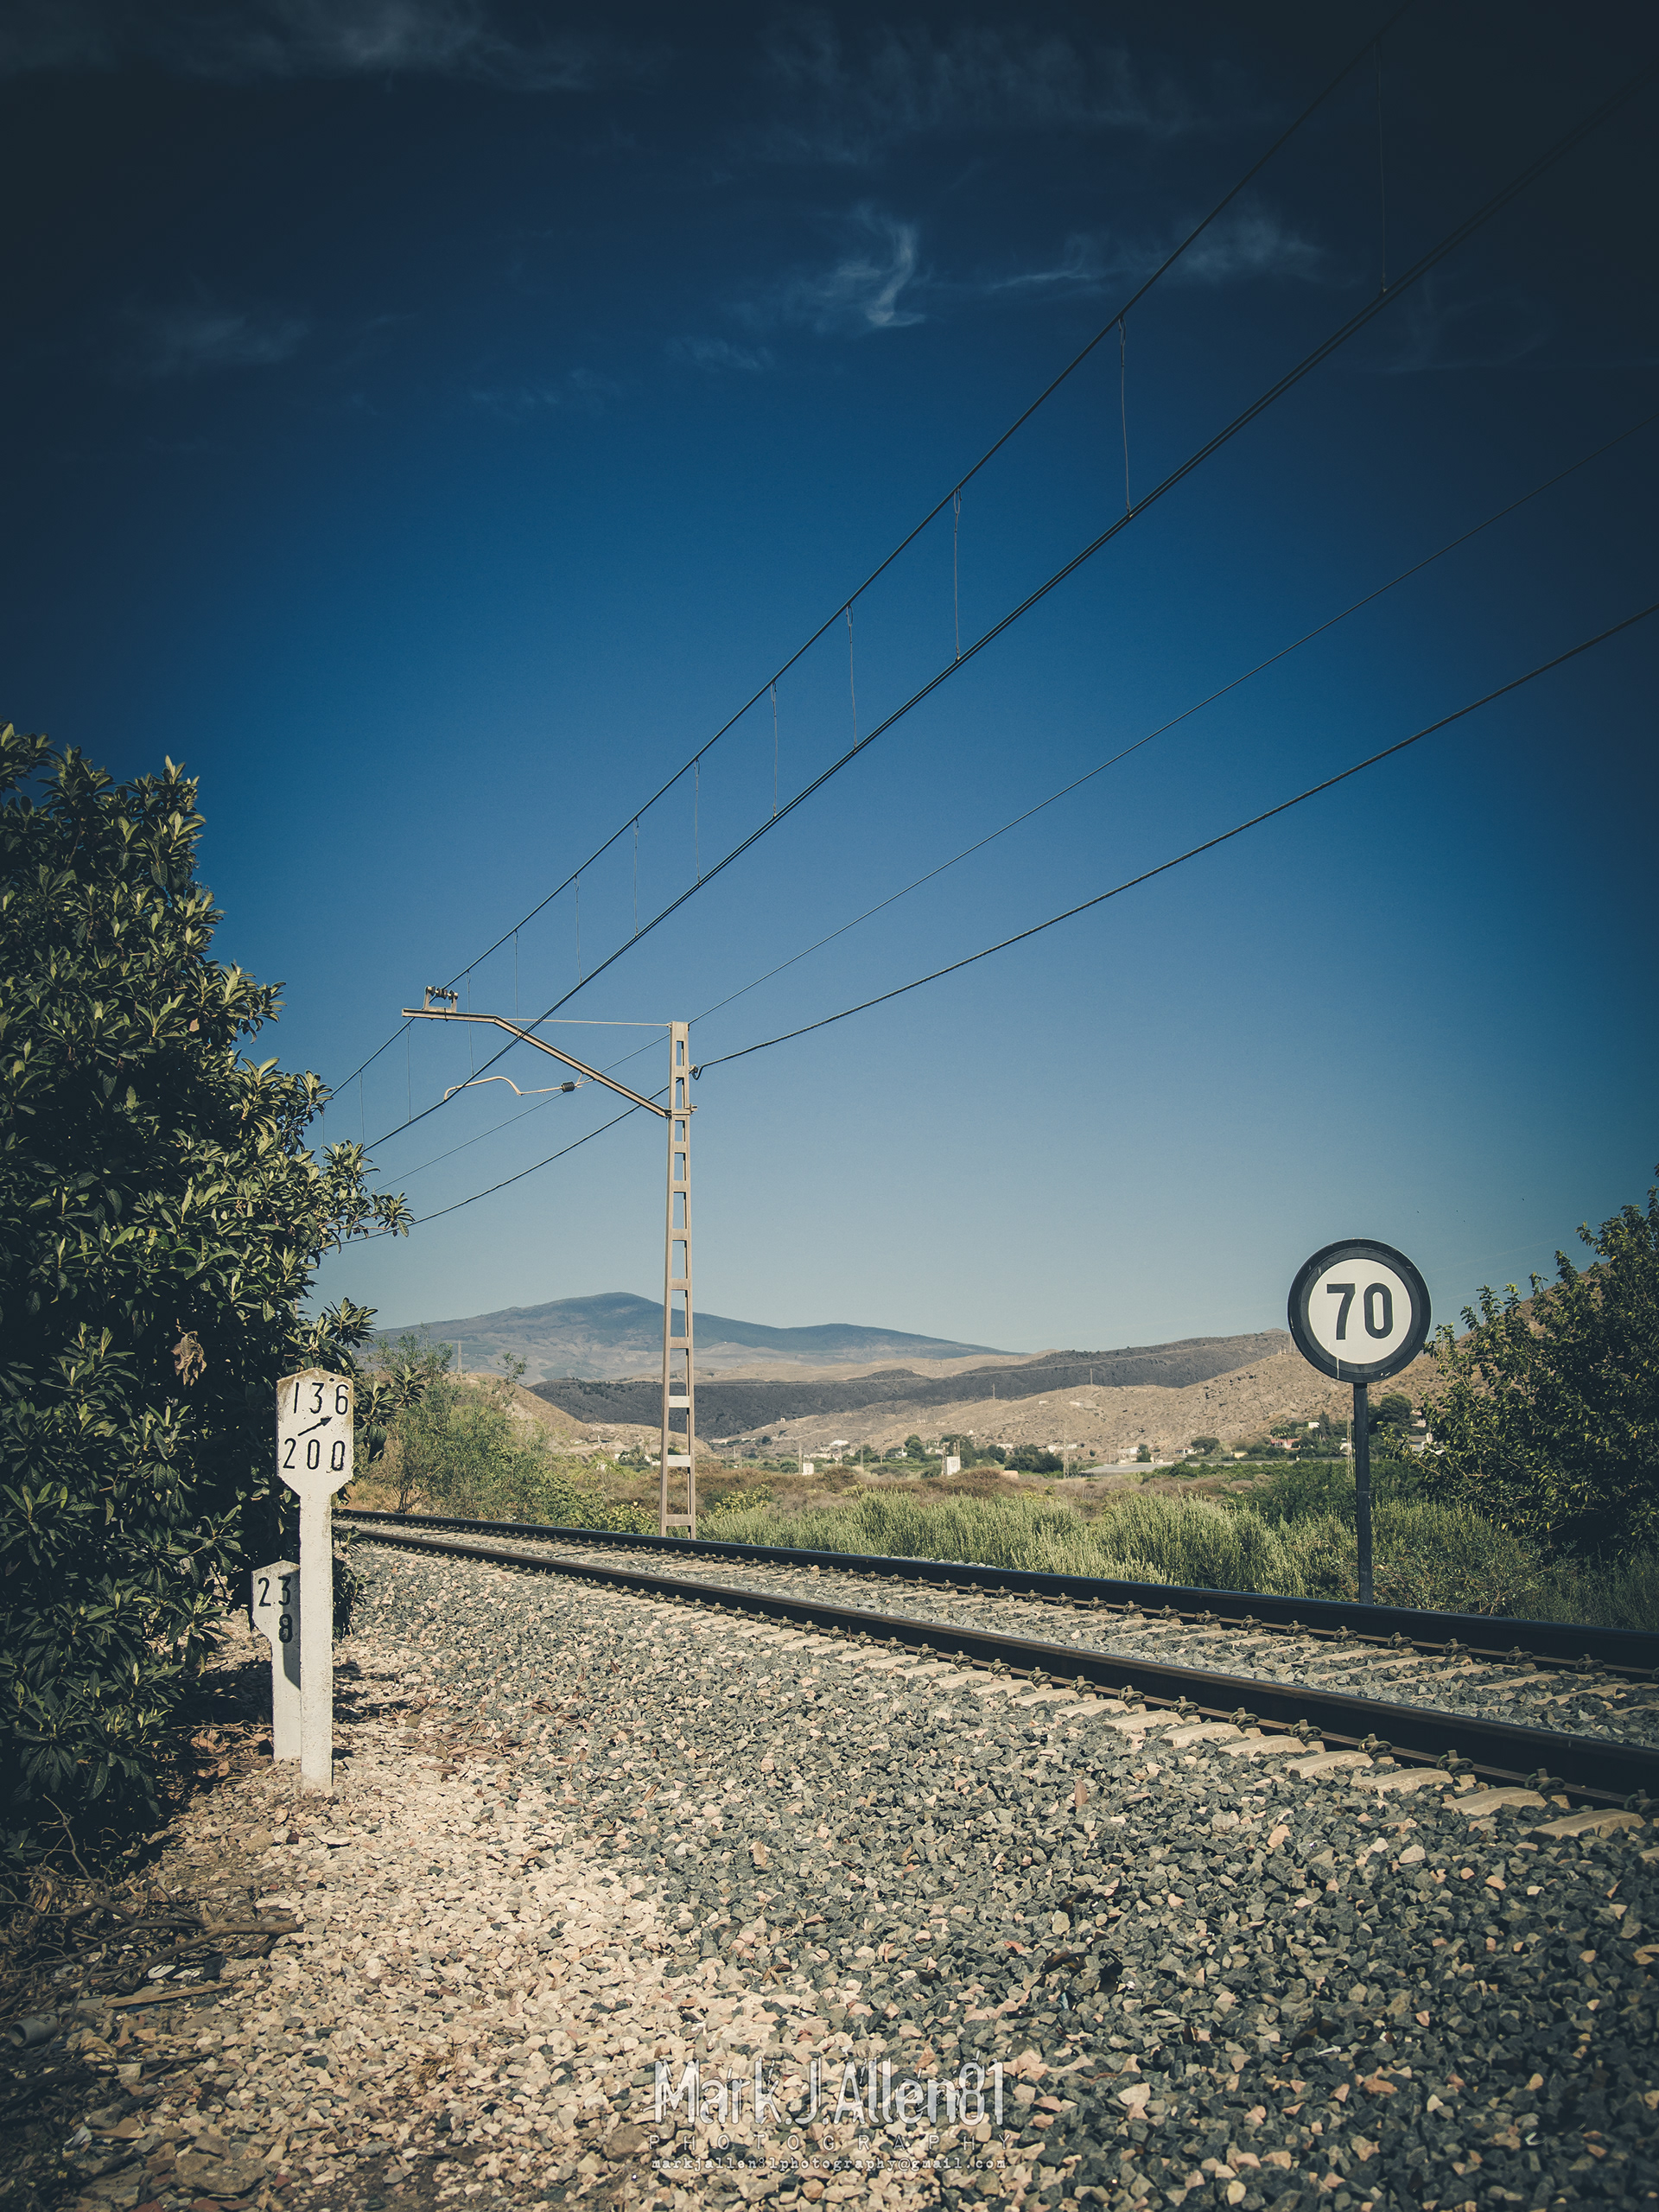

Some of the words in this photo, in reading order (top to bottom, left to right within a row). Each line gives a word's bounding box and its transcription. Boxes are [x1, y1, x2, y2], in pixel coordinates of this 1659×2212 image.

[1326, 1282, 1393, 1340] 70
[294, 1382, 349, 1414] 136
[283, 1438, 346, 1471] 200
[278, 1614, 292, 1643] 8
